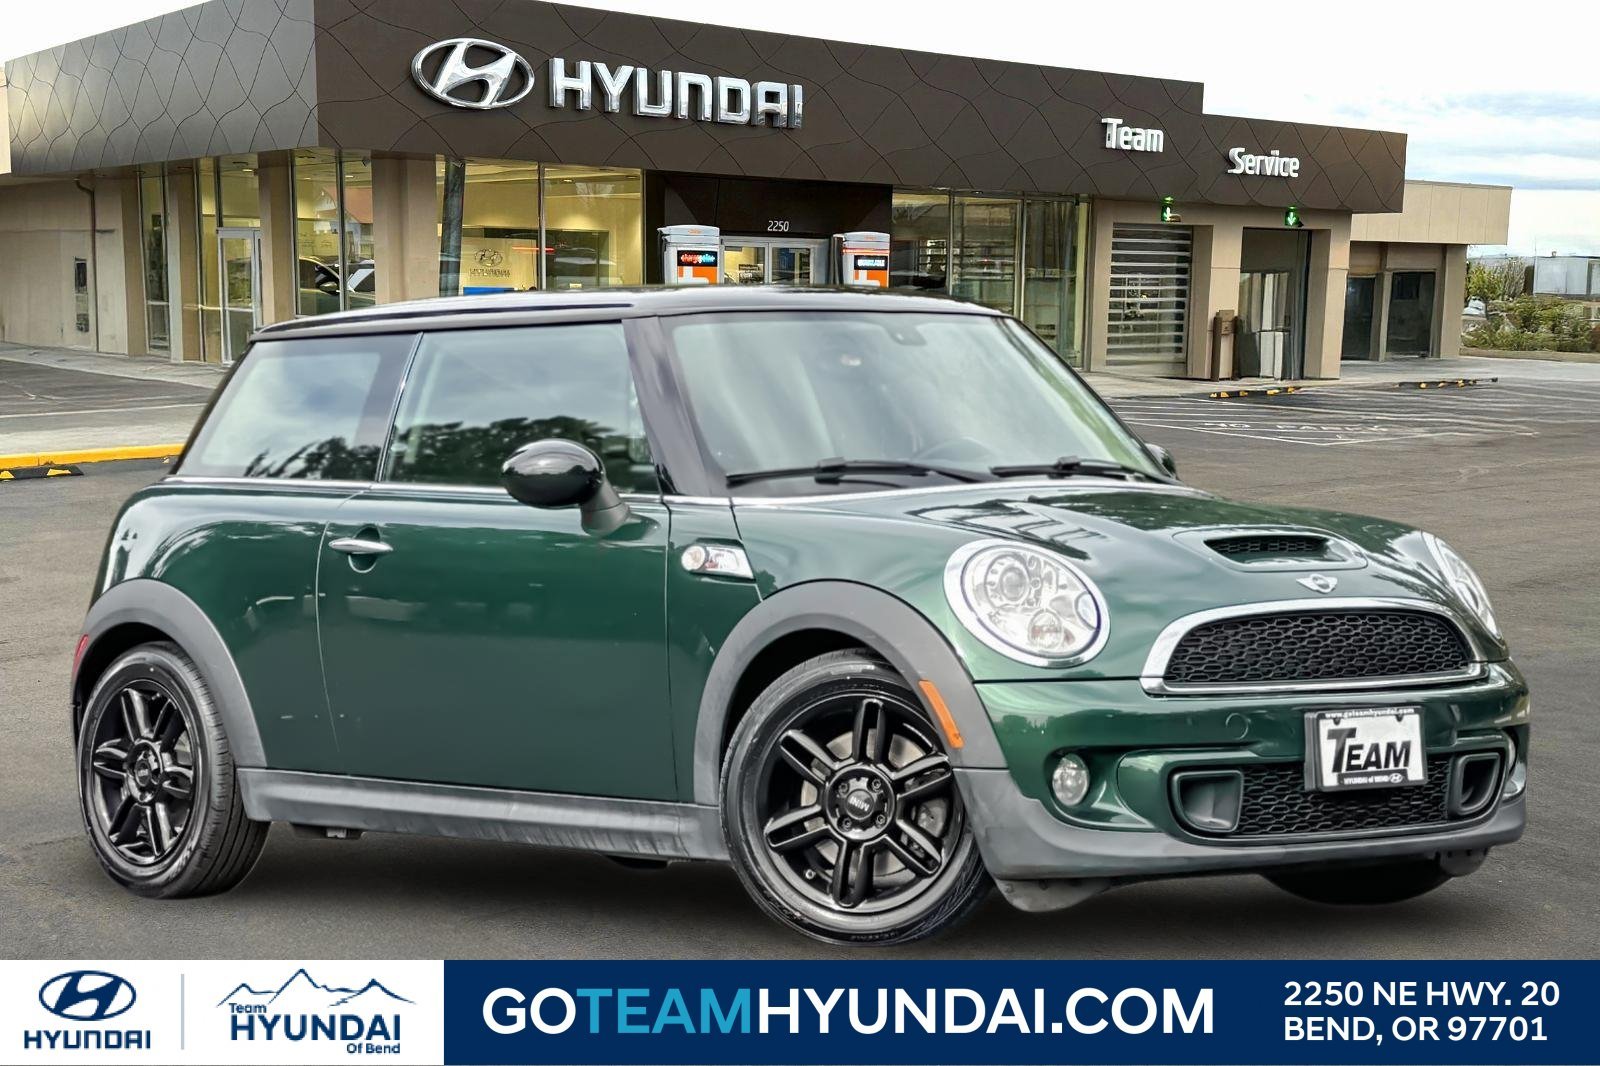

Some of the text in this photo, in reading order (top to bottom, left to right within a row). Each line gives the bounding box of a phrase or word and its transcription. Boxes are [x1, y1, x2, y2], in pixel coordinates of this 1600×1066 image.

[549, 57, 803, 128] HYUNDAI
[1101, 118, 1164, 152] Team
[1228, 147, 1300, 177] Service
[767, 220, 790, 232] 2250
